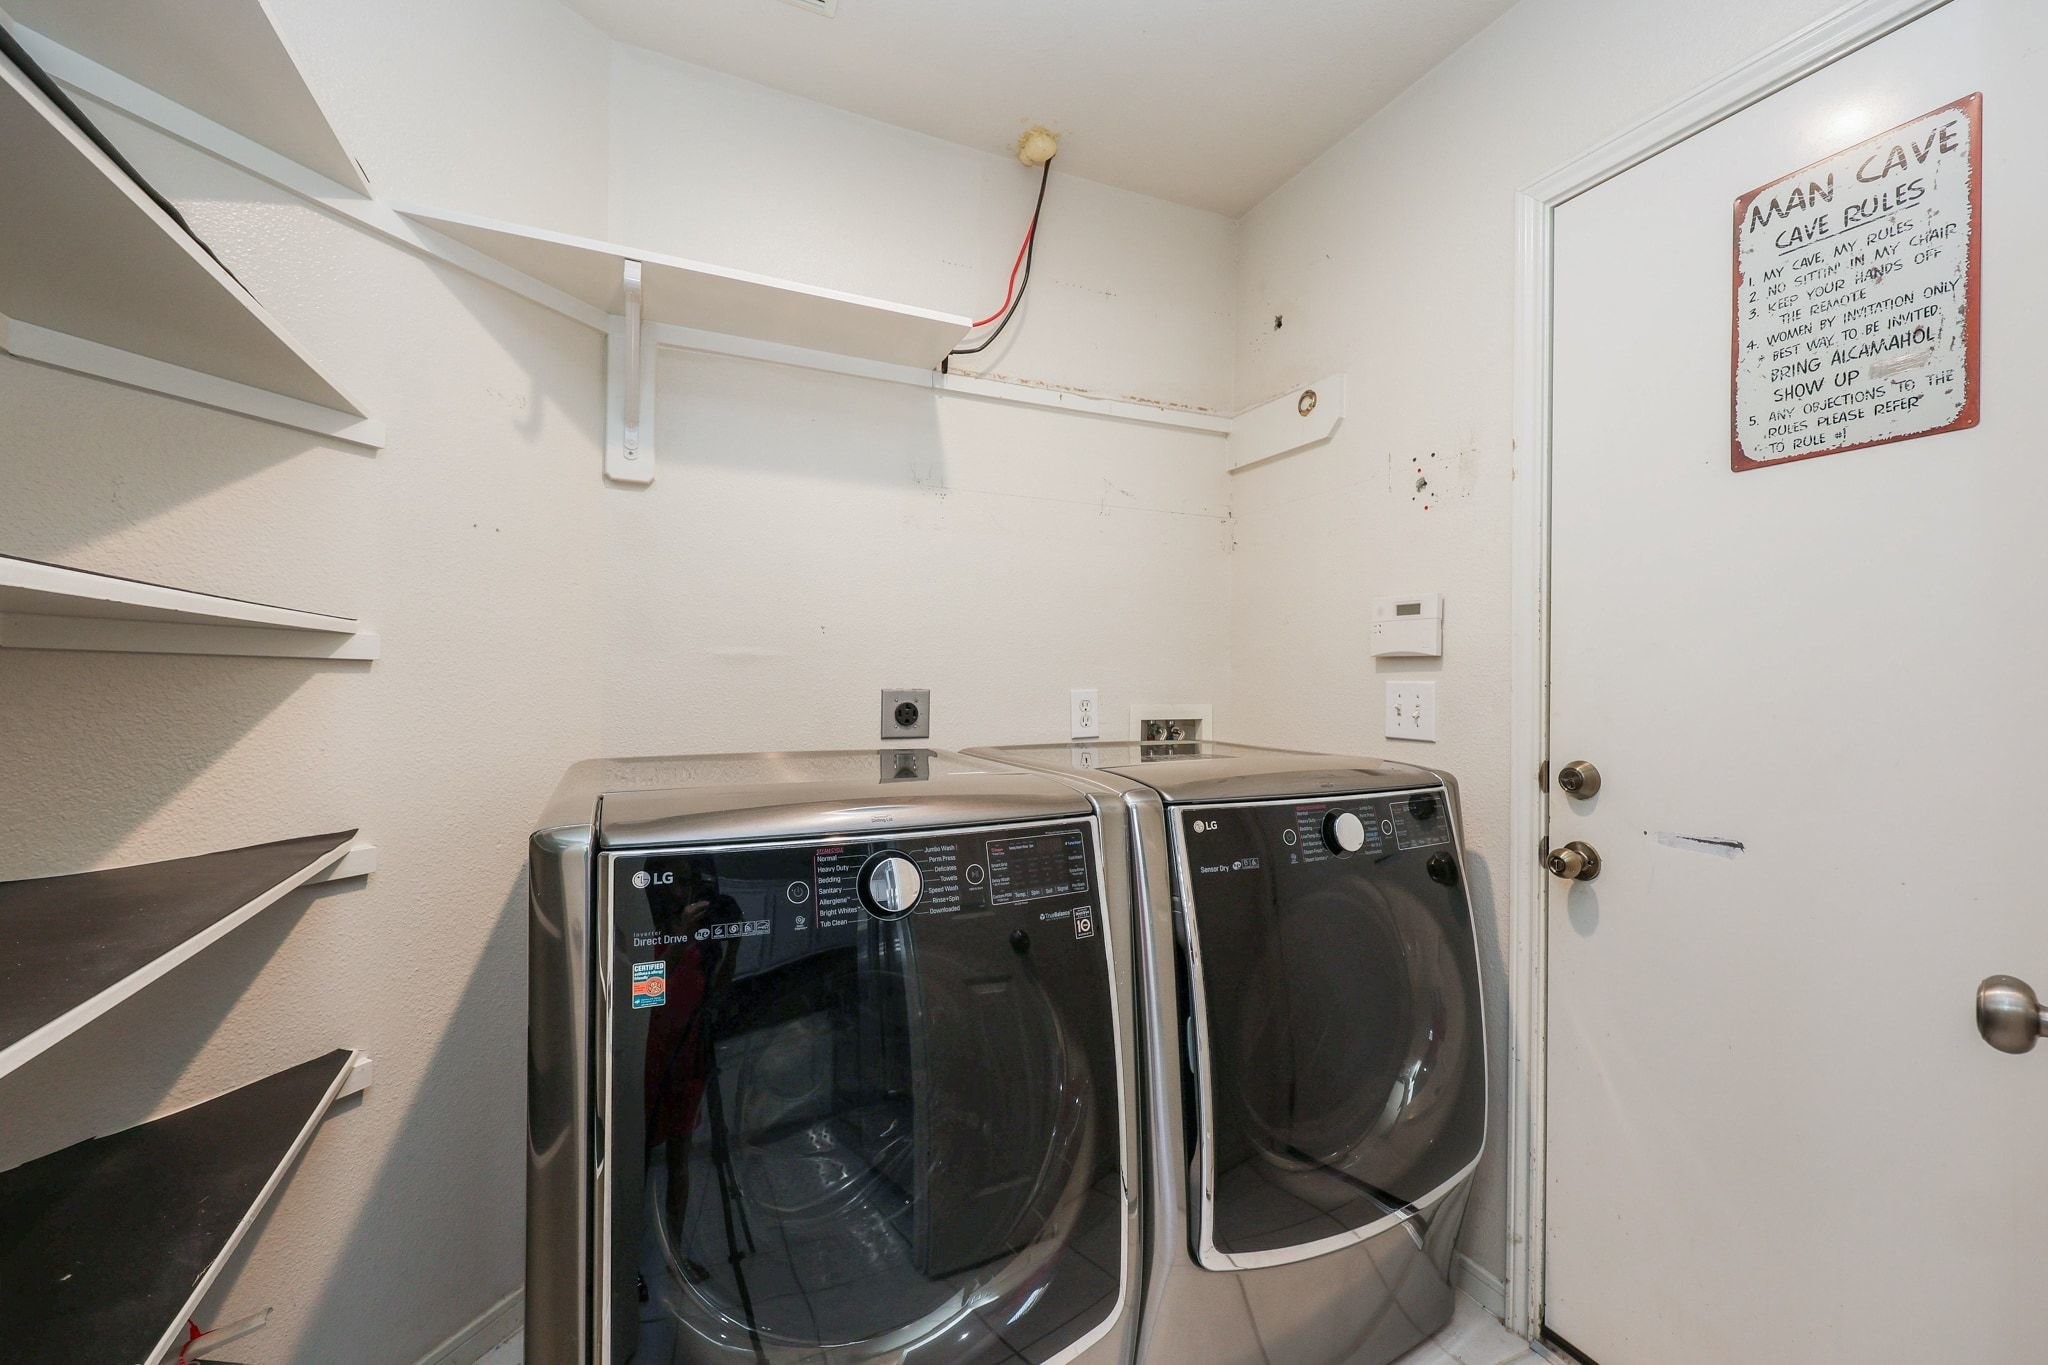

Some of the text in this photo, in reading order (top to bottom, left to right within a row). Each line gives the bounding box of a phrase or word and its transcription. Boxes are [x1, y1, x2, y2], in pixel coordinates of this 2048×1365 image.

[1749, 120, 1958, 233] MAN CAVE
[1775, 178, 1925, 249] CAVE RULES
[1763, 267, 1784, 284] MY
[1833, 241, 1857, 258] MY
[1866, 219, 1914, 246] RULES
[1768, 283, 1787, 297] NO
[1850, 254, 1865, 268] IN
[1874, 242, 1900, 260] MY
[1909, 223, 1957, 247] CHAIR
[1768, 294, 1799, 313] KEEP
[1807, 279, 1845, 298] YOUR
[1855, 259, 1904, 285] HANDS
[1914, 246, 1942, 265] OFF
[1766, 324, 1813, 347] WOMEN
[1819, 316, 1836, 331] BY
[1843, 293, 1914, 325] INVITATION
[1923, 277, 1960, 299] ONLY
[1779, 288, 1867, 325] THE REMOTE
[1772, 344, 1801, 362] BEST
[1841, 328, 1858, 341] TO
[1865, 321, 1880, 336] BE
[1771, 357, 1822, 383] BRING
[1773, 370, 1860, 402] SHOW UP
[1749, 369, 1954, 427] 5. ANY OBJECTIONS TO THE
[1768, 396, 1920, 439] RULES PLEASE REFER
[1768, 440, 1785, 454] TO
[1793, 433, 1826, 450] RULE
[1205, 821, 1218, 830] LG
[653, 872, 674, 885] LG
[818, 876, 841, 884] Bedding
[820, 909, 837, 917] Bright
[929, 905, 960, 914] Downloaded
[633, 936, 661, 947] Direct
[663, 934, 688, 944] Drive
[1077, 919, 1091, 933] 10
[634, 962, 664, 972] CERTIFIED
